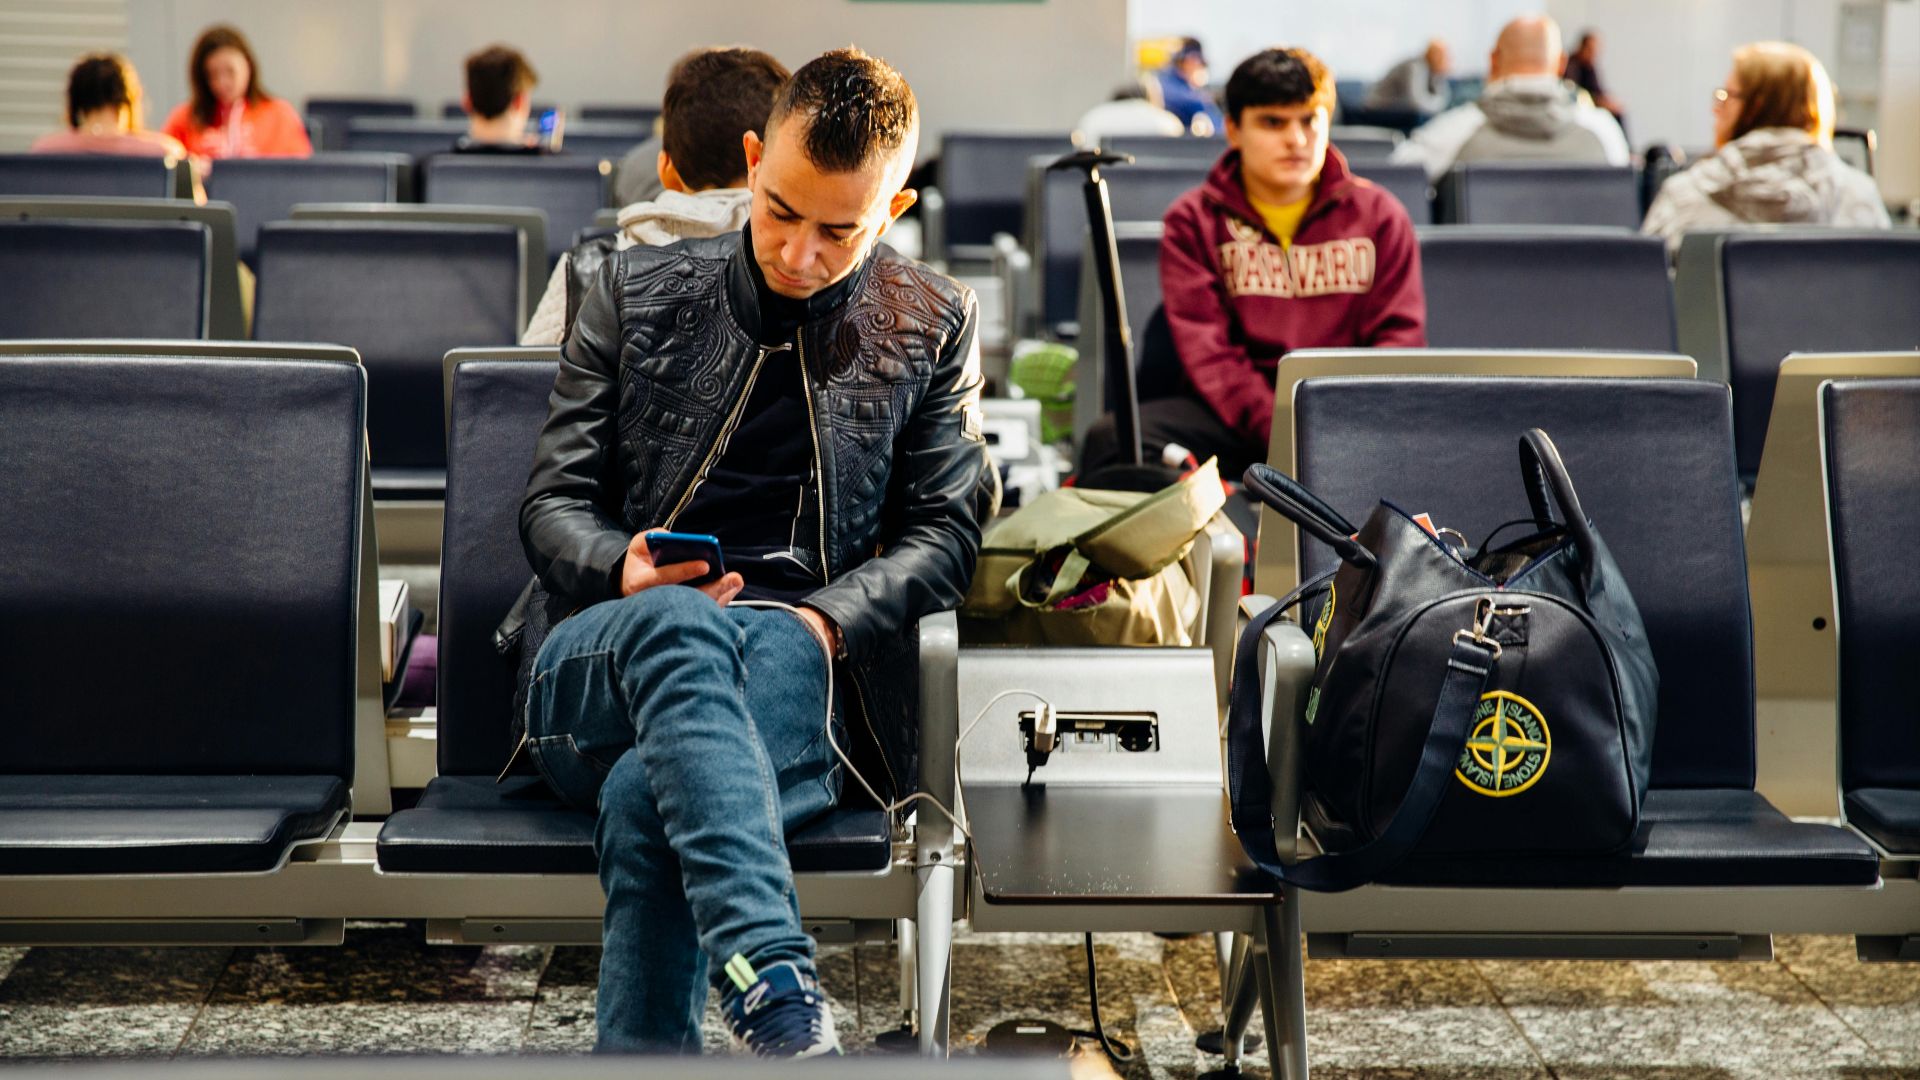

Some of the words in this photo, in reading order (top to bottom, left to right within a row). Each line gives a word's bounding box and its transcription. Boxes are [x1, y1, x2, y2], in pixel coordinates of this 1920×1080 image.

[1219, 237, 1376, 298] HARVARD
[1504, 701, 1542, 742] ISLAND
[1460, 748, 1494, 788] ISLAN
[1502, 752, 1541, 788] STONE
